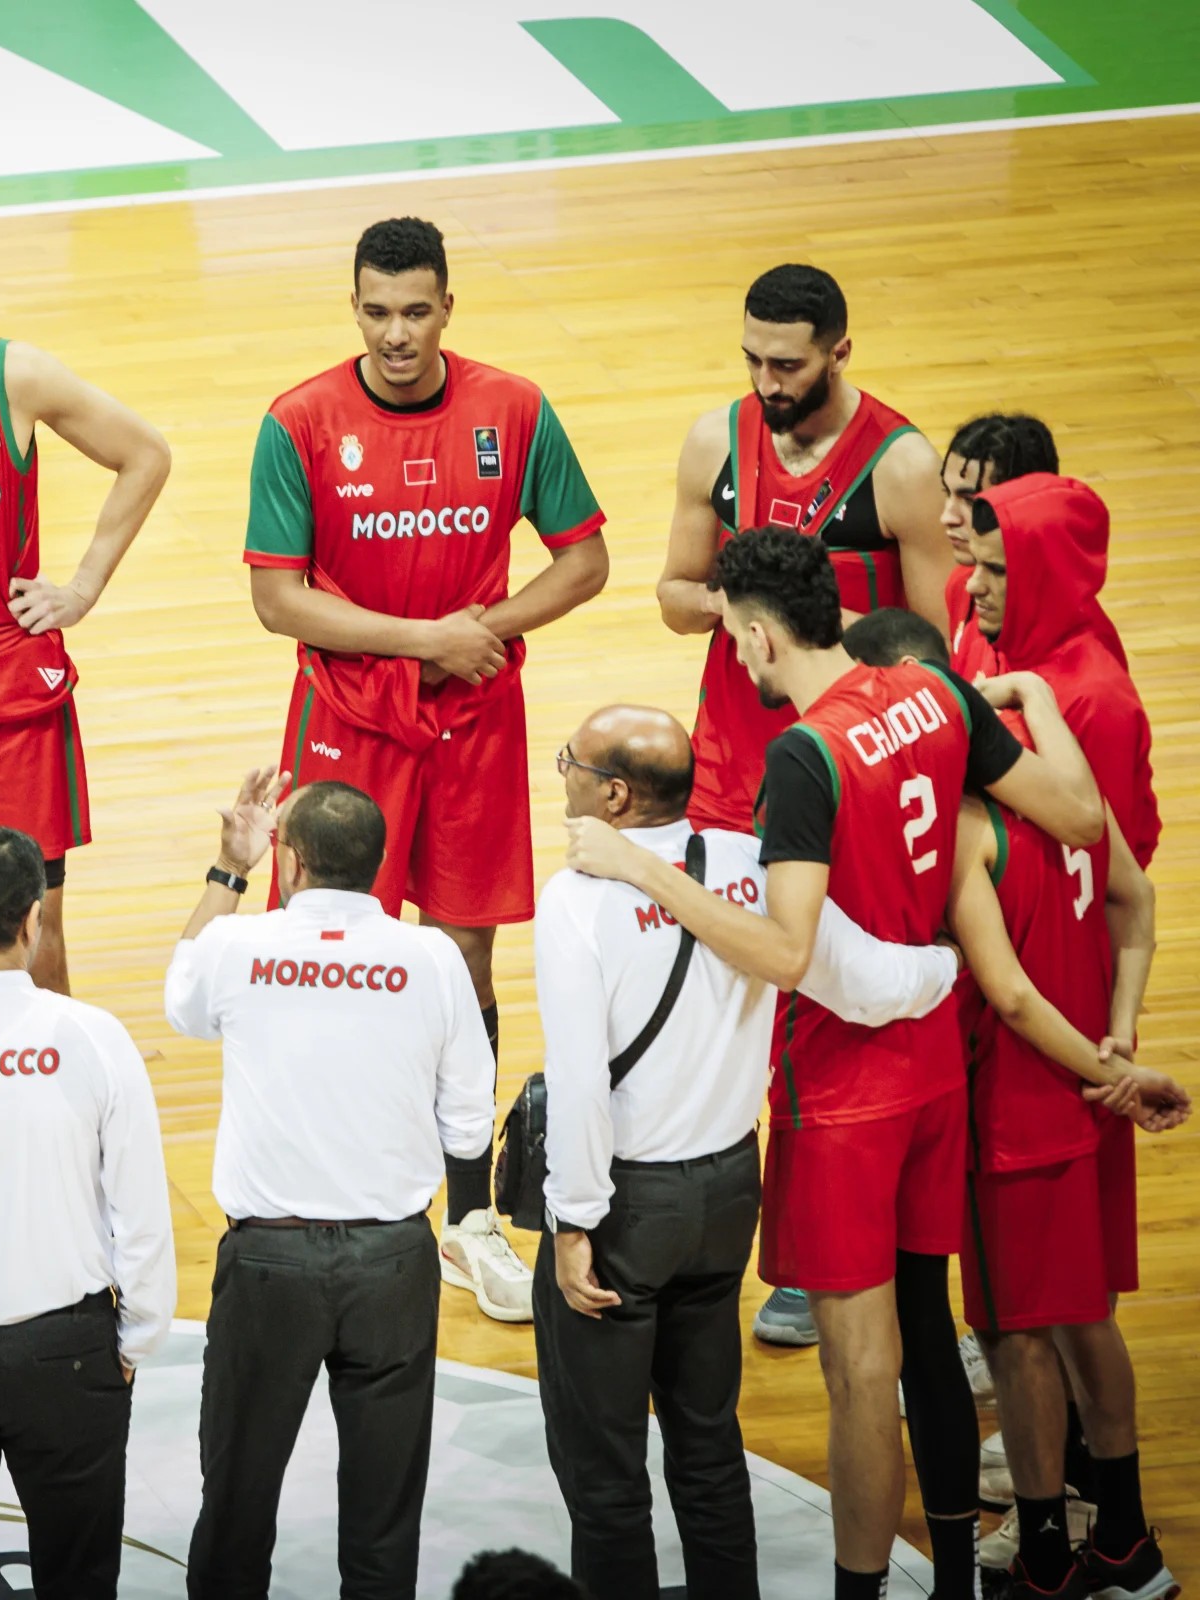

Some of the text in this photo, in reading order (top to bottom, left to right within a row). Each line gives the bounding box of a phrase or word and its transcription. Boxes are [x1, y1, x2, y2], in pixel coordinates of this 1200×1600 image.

[335, 482, 375, 498] vive
[351, 505, 491, 540] MOROCCO
[310, 740, 342, 760] vive
[899, 773, 938, 876] 2
[249, 957, 409, 994] MOROCCO
